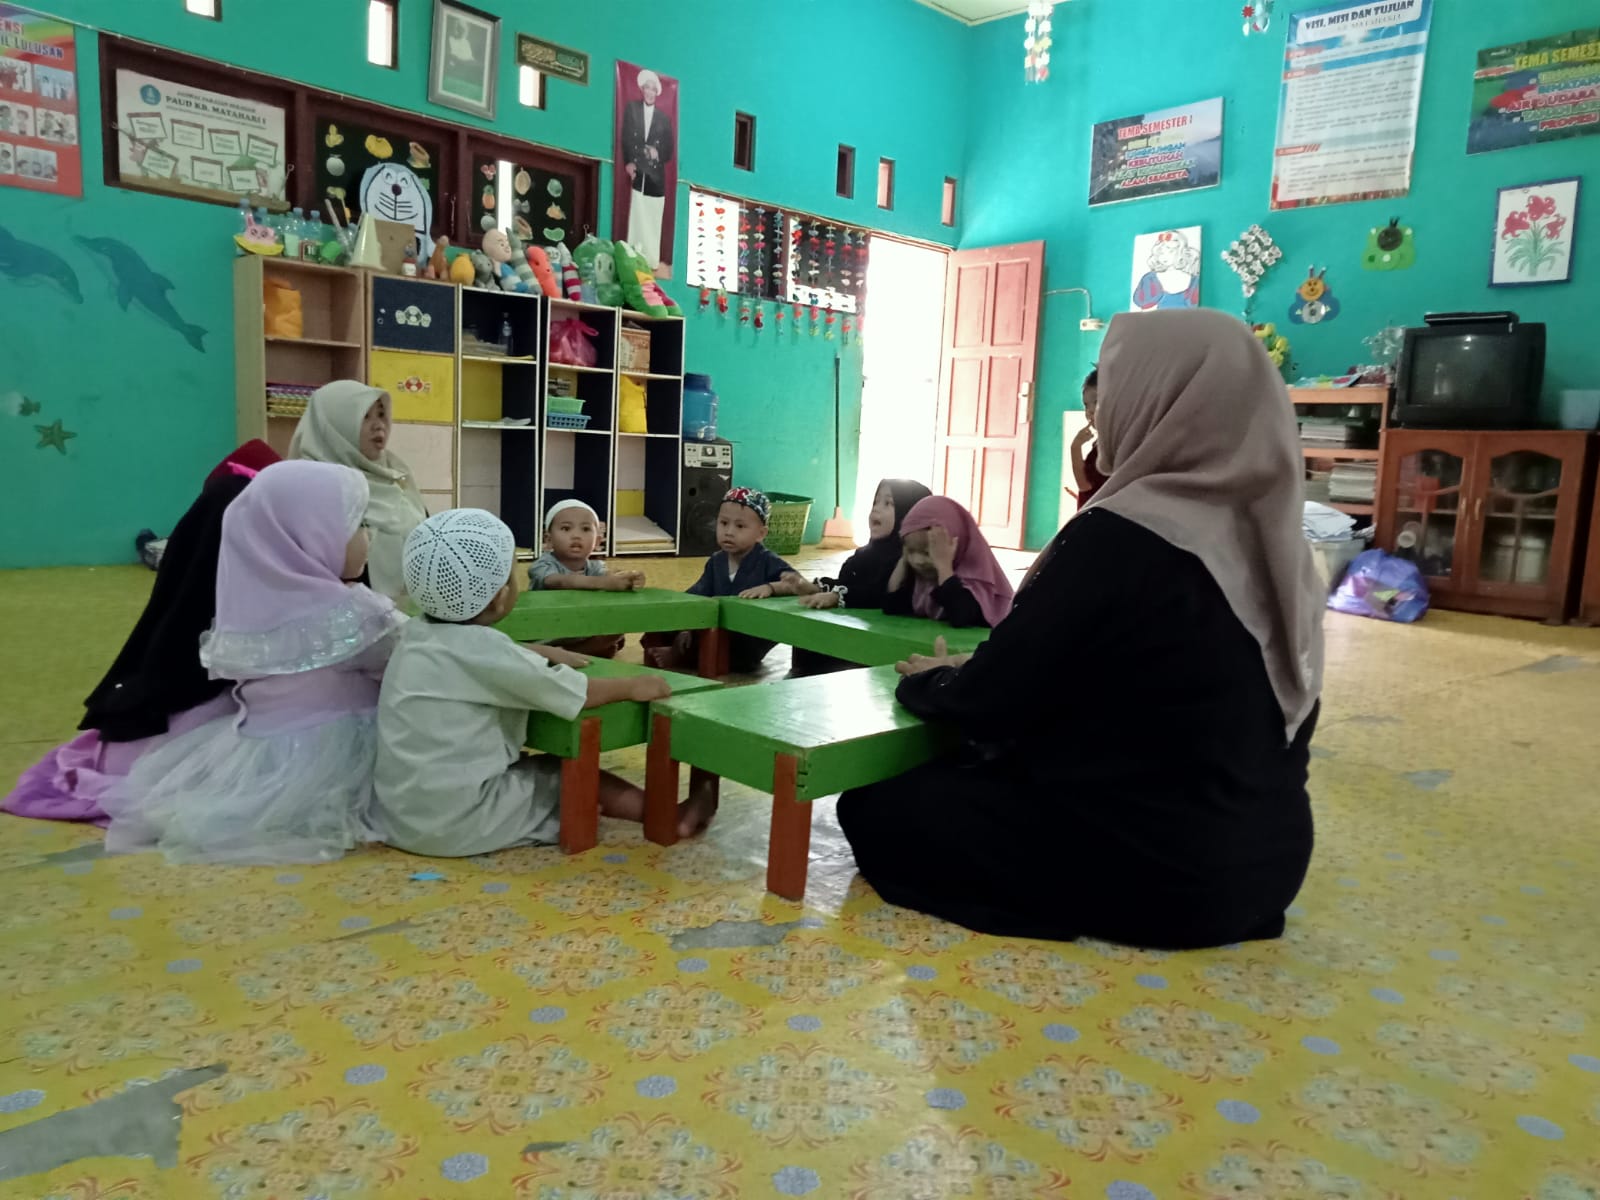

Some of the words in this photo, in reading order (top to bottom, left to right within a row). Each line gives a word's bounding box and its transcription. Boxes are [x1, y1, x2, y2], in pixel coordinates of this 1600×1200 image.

[1328, 12, 1350, 25] MISI
[1351, 8, 1373, 20] DAN
[1373, 0, 1415, 16] TUJUAN
[15, 36, 64, 59] LULUSAN
[1514, 52, 1549, 72] TEMA
[165, 95, 193, 107] PAUD
[211, 106, 261, 124] MATAHARI
[1142, 115, 1188, 134] SEMESTER
